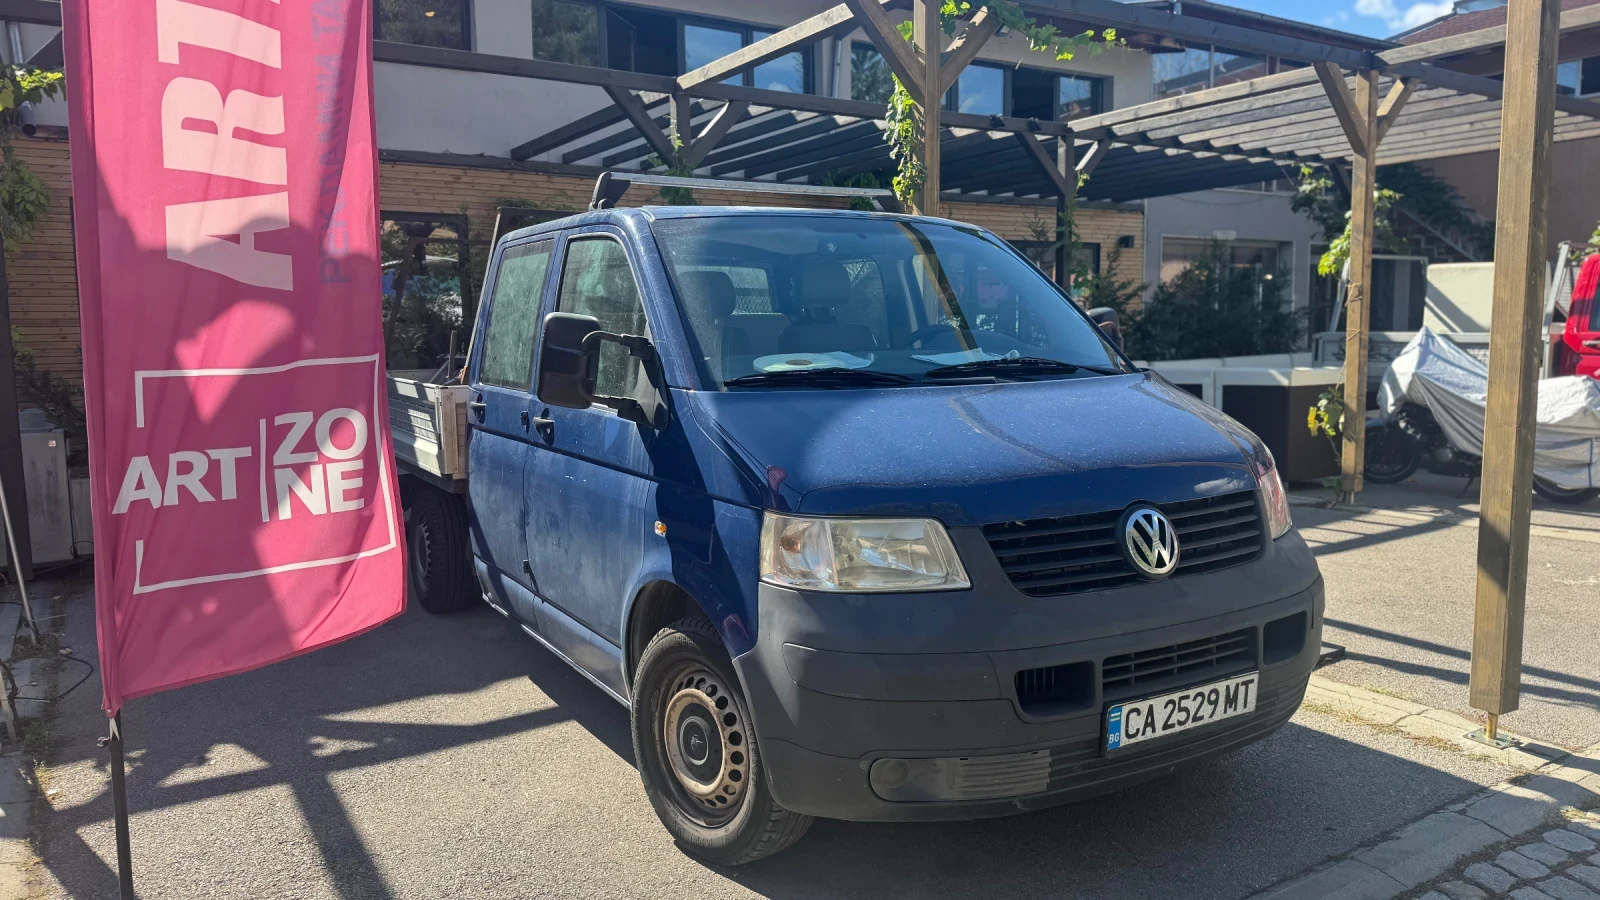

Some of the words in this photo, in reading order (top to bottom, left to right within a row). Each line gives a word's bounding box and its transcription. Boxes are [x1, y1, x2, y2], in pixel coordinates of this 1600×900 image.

[156, 0, 294, 291] ART
[112, 446, 252, 515] ART
[1126, 509, 1178, 574] VW
[1109, 732, 1120, 744] BG
[1124, 704, 1156, 739] CA
[1162, 687, 1220, 730] 2529
[1223, 678, 1254, 714] MT
